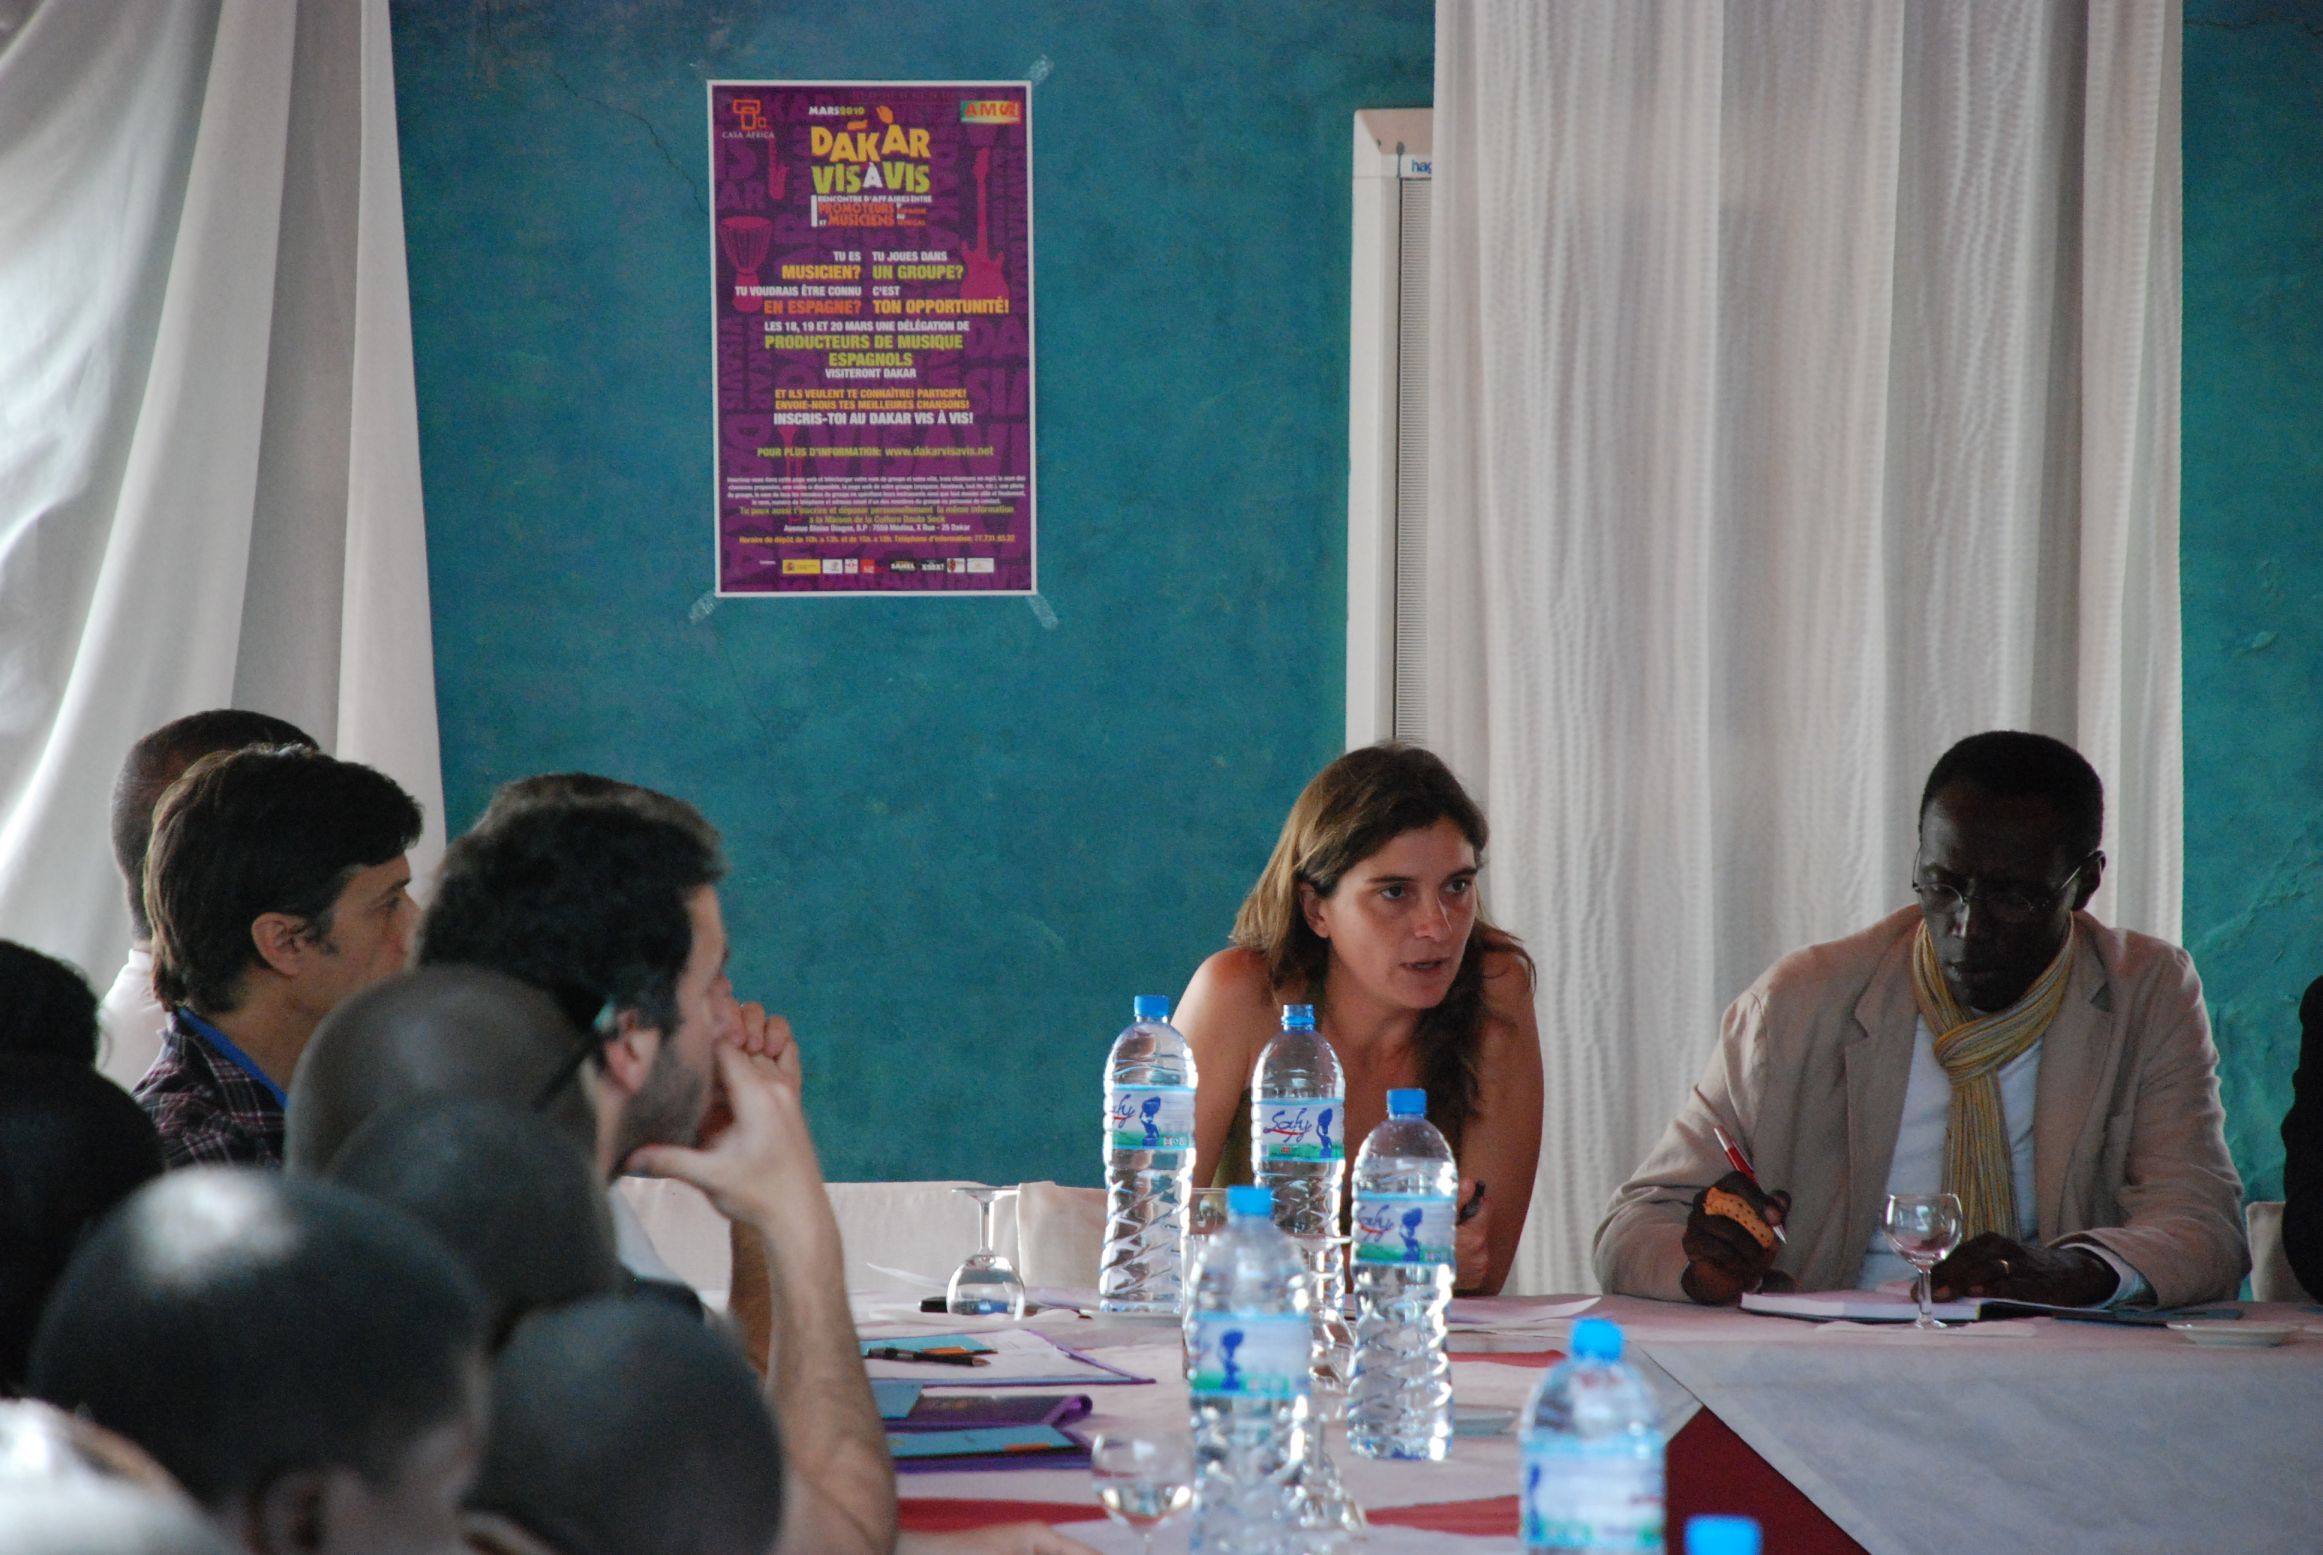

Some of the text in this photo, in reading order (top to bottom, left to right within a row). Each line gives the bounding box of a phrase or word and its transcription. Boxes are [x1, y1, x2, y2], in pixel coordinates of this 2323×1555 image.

[745, 131, 775, 139] AFRICA
[818, 203, 894, 214] PROMOTEURS
[828, 214, 894, 226] MUSICIENS
[833, 251, 861, 262] TU ES
[872, 251, 947, 262] TU JOUES DANS
[781, 265, 861, 280] MUSICIEN?
[872, 264, 964, 280] UN GROUPE?
[735, 284, 862, 297] TU VOUDRAIS ÊTRE CONNU
[872, 285, 900, 297] C'EST
[764, 300, 861, 314] EN ESPAGNE?
[873, 296, 1010, 314] TON OPPORTUNITÉ!
[764, 321, 782, 332] LES
[785, 321, 801, 333] 18,
[803, 321, 815, 332] 19
[817, 321, 828, 332] ET
[830, 321, 843, 332] 20
[845, 321, 873, 332] MARS
[876, 321, 895, 332] UNE
[956, 321, 970, 332] DE
[765, 335, 963, 349] PRODUCTEURS DE MUSIQUE
[829, 353, 912, 367] ESPAGNOLS
[825, 368, 917, 378] VISITERONT DAKAR
[775, 389, 787, 398] ET
[789, 389, 803, 398] ILS
[805, 389, 845, 398] VEULENT
[848, 389, 858, 398] TE
[917, 388, 967, 398] PARTICIPE!
[839, 400, 855, 409] TES
[858, 400, 914, 409] MEILLEURES
[917, 400, 970, 409] CHANSONS!
[774, 413, 847, 425] INSCRIS-TOI
[849, 413, 866, 425] AU
[869, 412, 911, 425] DAKAR
[914, 412, 934, 425] VIS
[949, 412, 974, 425] VIS!
[757, 447, 782, 457] POUR
[784, 447, 807, 457] PLUS
